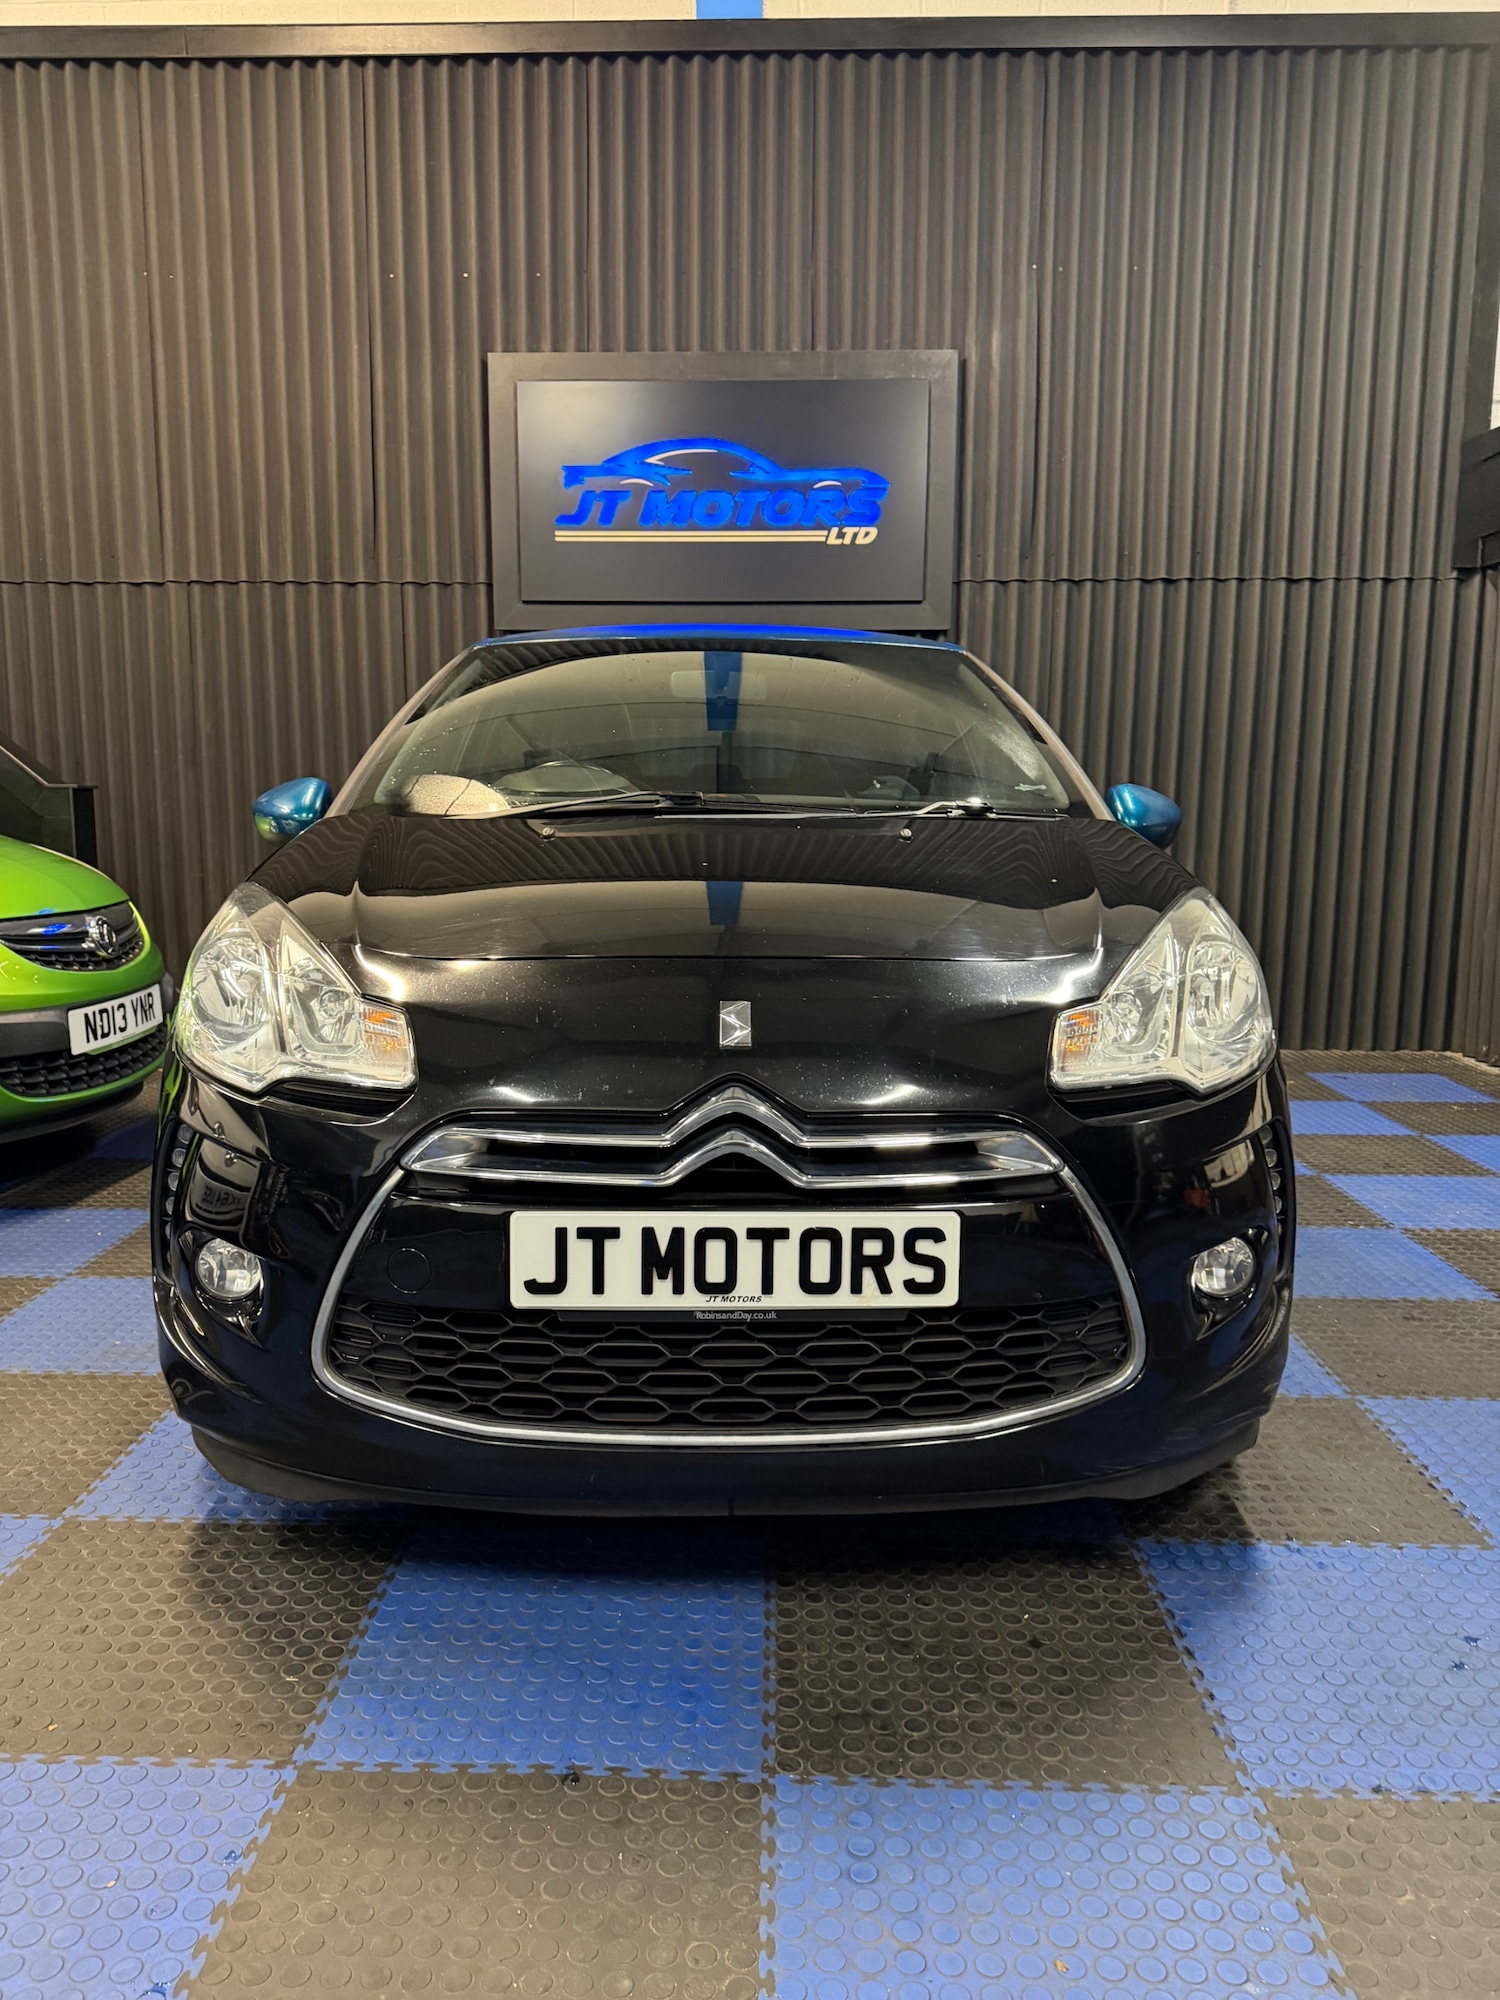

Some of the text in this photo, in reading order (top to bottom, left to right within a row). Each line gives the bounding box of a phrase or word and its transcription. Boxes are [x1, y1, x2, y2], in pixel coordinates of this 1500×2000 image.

[554, 489, 889, 527] JT MOTORS
[826, 526, 878, 545] LTD
[83, 1001, 128, 1043] ND13
[130, 992, 156, 1027] YNR
[523, 1226, 948, 1296] JT MOTORS
[705, 1295, 763, 1303] JT MOTORS
